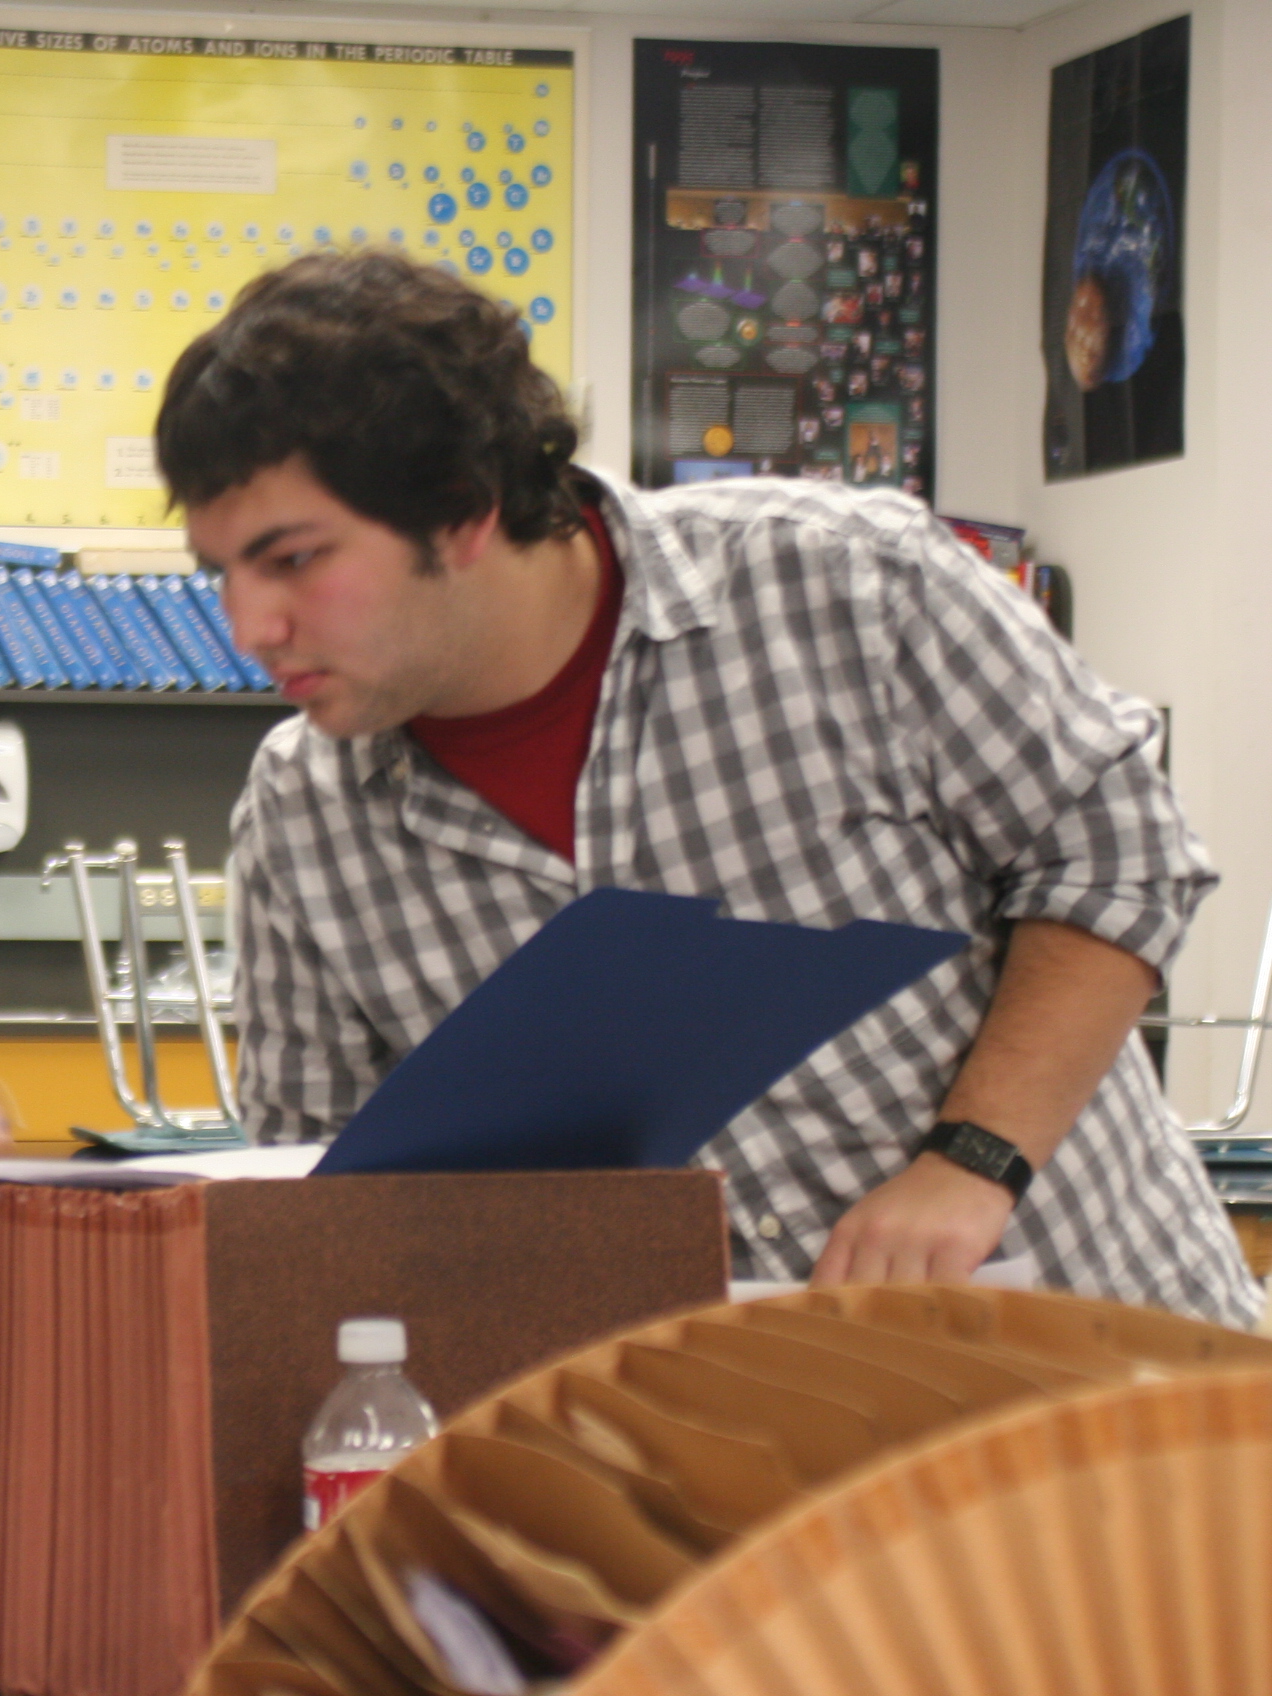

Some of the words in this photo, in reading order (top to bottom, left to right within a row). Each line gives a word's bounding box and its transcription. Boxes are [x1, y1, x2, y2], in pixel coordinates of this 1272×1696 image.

[35, 31, 85, 51] SIZES
[93, 35, 119, 51] OF
[128, 36, 194, 55] ATOMS
[204, 39, 246, 57] AND
[253, 41, 298, 59] IONS
[305, 42, 327, 60] IN
[334, 43, 366, 61] THE
[375, 45, 456, 65] PERIODIC
[463, 49, 515, 67] TABLE
[10, 602, 49, 665] GIANCOLI
[35, 603, 77, 667] GIANCOLI
[61, 604, 102, 667] GIANCOLI
[85, 605, 126, 667] GIANCOLI
[113, 607, 155, 668] GIANCOLI
[135, 608, 178, 669] GIANCOLI
[163, 608, 205, 669] GIANCOLI
[186, 609, 229, 669] GIANCOLI
